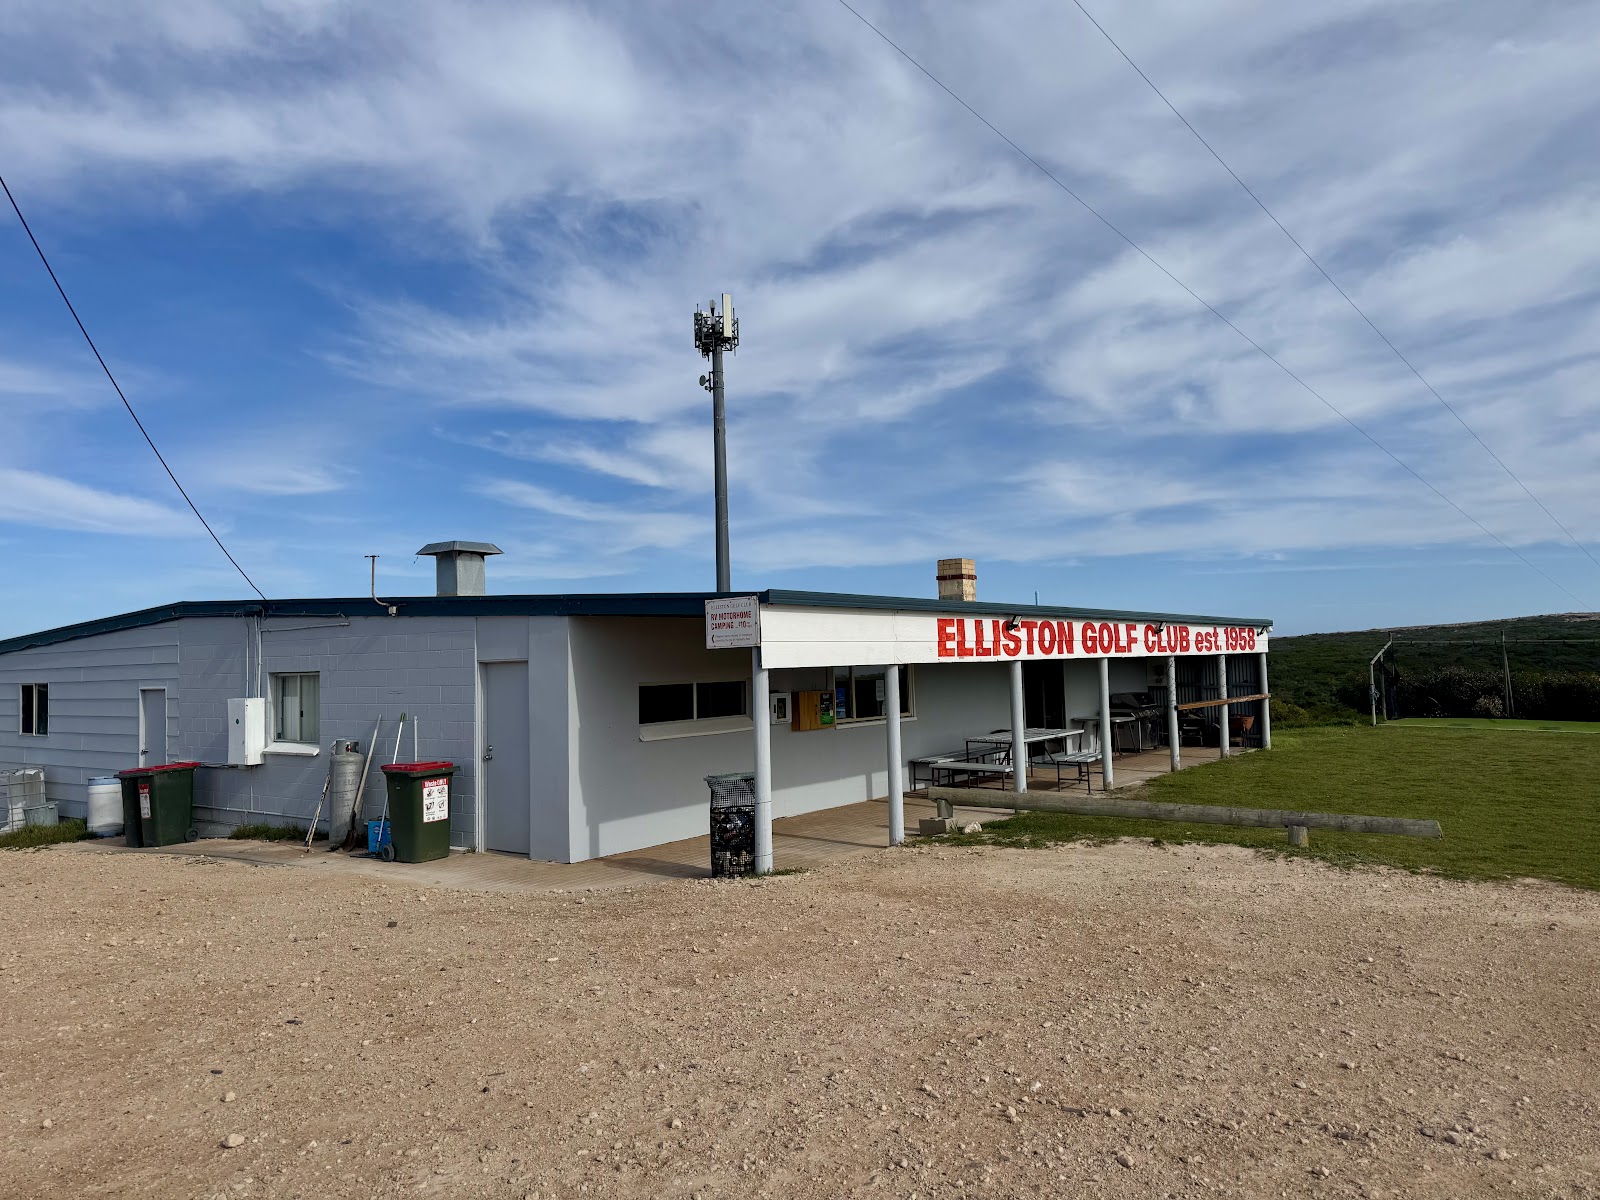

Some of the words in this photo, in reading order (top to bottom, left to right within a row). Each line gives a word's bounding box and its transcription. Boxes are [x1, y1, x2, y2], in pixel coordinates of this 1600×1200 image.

[711, 613, 718, 621] RV
[719, 611, 752, 621] MOTORHOME
[711, 621, 734, 630] CAMPING
[936, 618, 1075, 657] ELLISTON
[1081, 621, 1138, 654] GOLF
[1143, 623, 1191, 653] CLUB
[1194, 626, 1222, 652] est.
[1223, 626, 1256, 651] 1958
